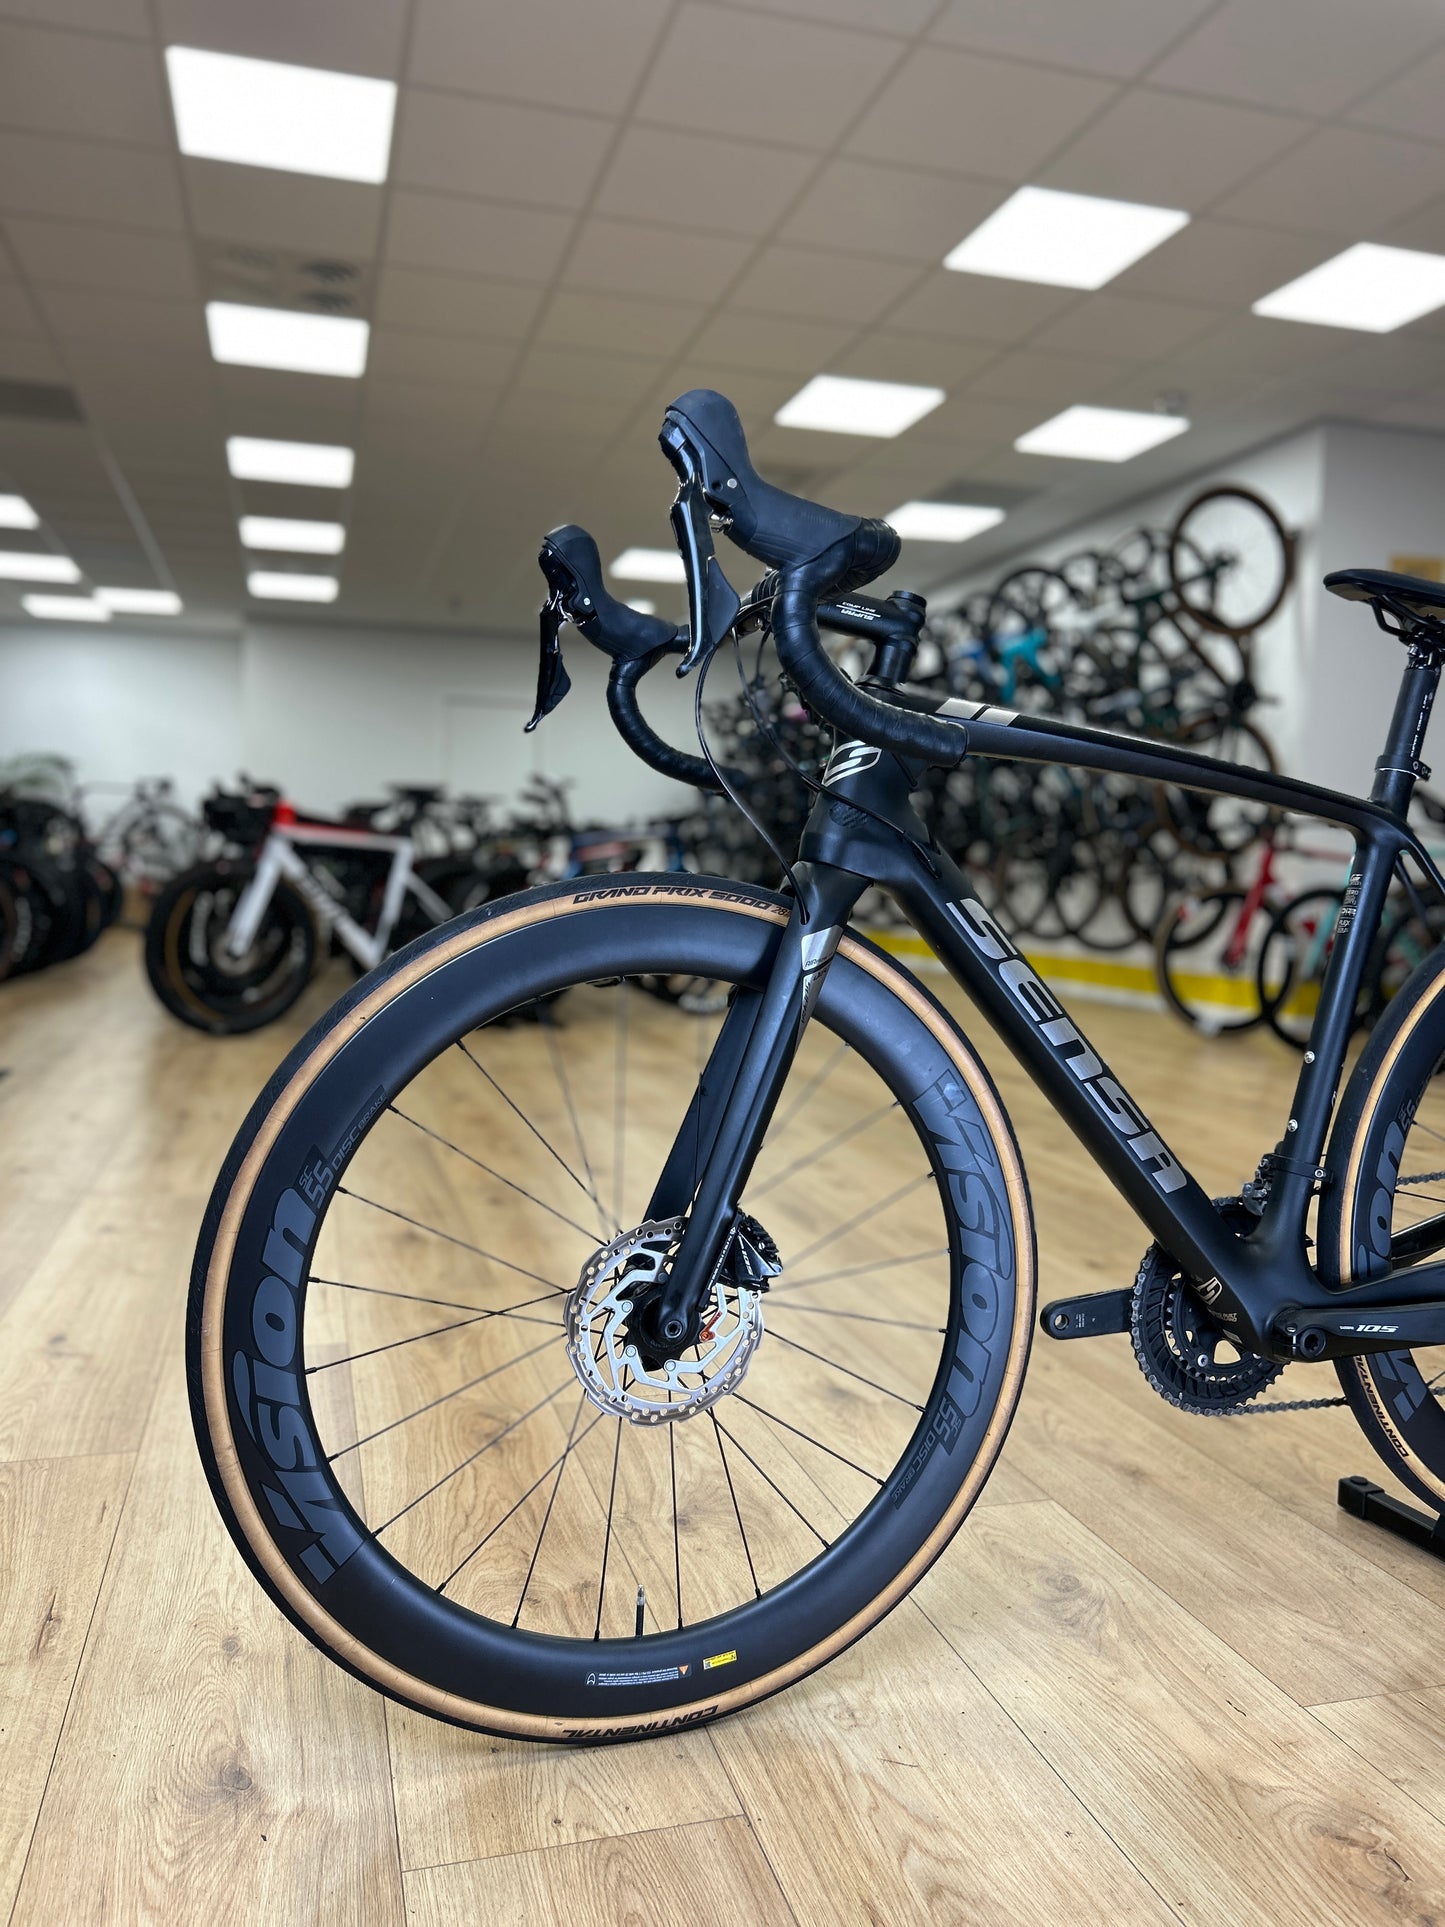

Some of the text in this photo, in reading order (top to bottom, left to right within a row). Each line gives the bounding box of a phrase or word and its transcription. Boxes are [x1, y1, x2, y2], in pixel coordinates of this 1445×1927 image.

[572, 886, 650, 905] GRAND
[652, 886, 709, 899] PRIX
[708, 891, 773, 911] 5000
[304, 1159, 334, 1209] 55
[331, 1126, 360, 1171] DISC
[1355, 1324, 1399, 1333] 105
[933, 1396, 958, 1442] 55
[912, 1430, 936, 1471] DISC
[562, 1705, 719, 1738] CONTINENTAL
